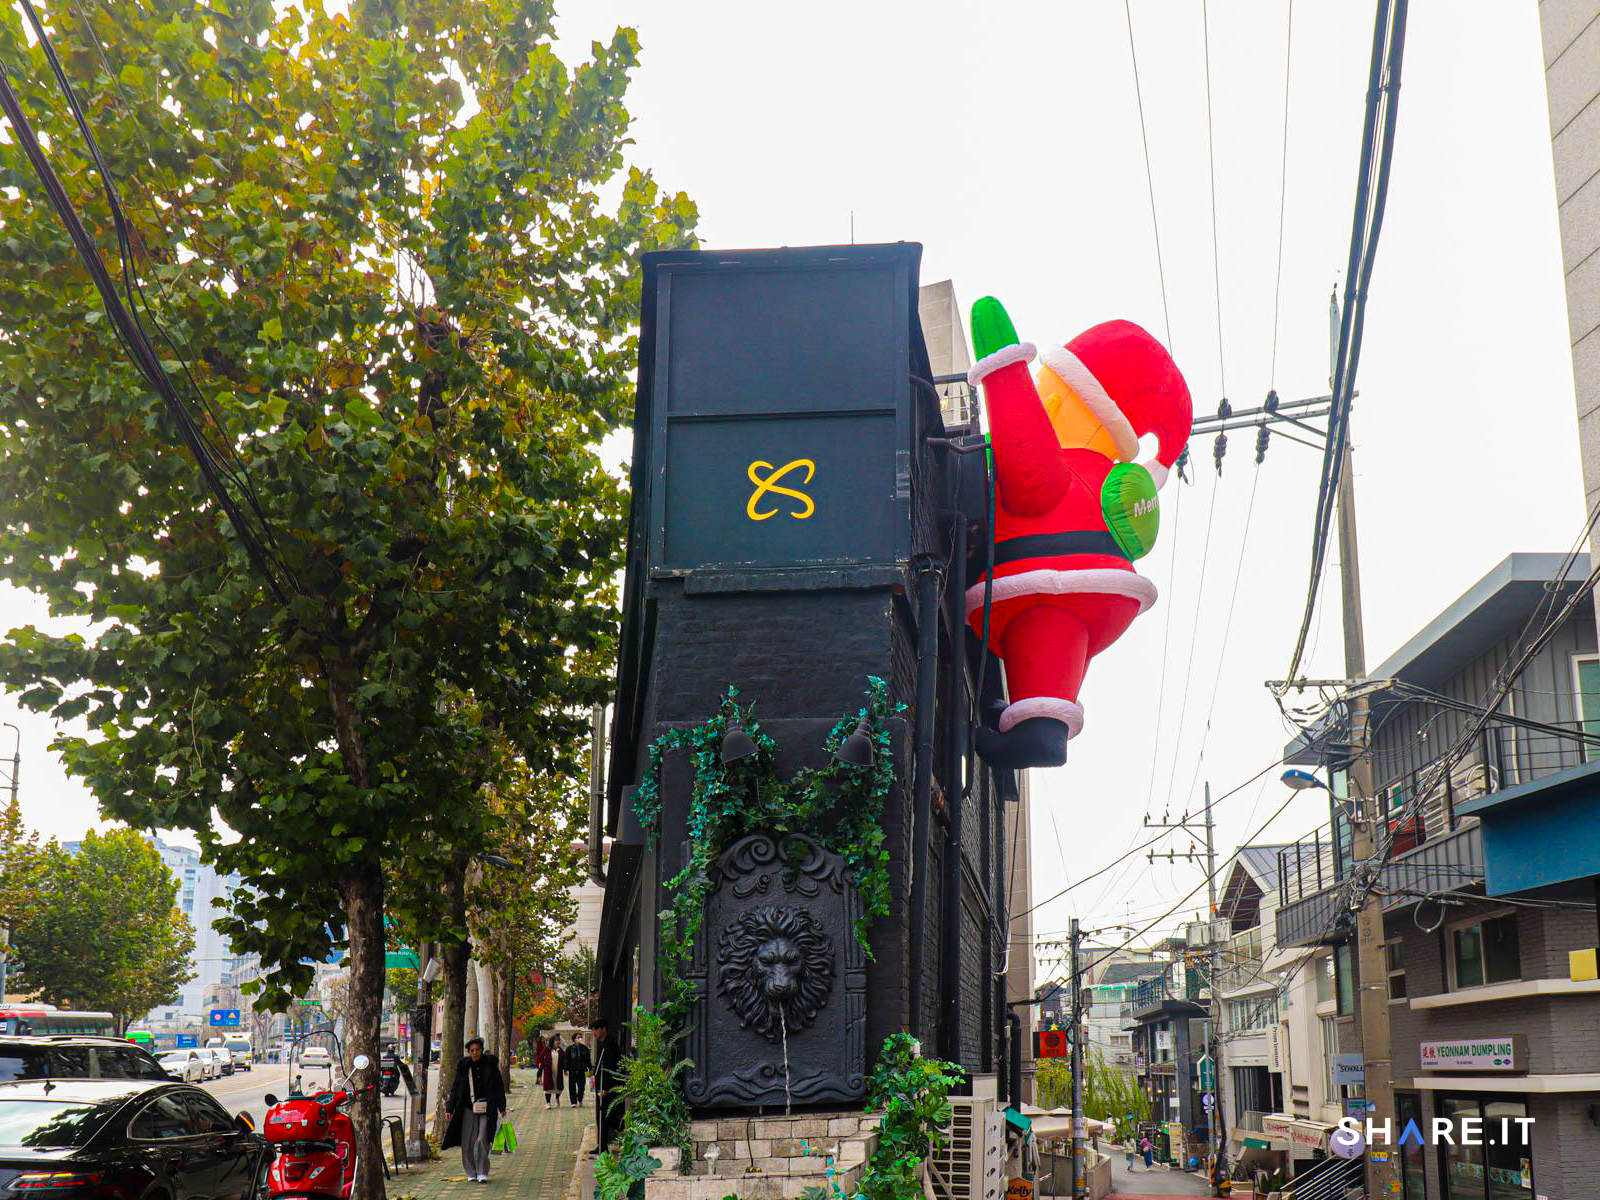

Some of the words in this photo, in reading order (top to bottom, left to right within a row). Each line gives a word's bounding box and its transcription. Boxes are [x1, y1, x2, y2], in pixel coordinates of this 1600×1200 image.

[1133, 496, 1159, 517] Merr
[1437, 1045, 1469, 1057] YEONNAM
[1471, 1043, 1511, 1056] DUMPLING
[1008, 1185, 1032, 1197] Kelly
